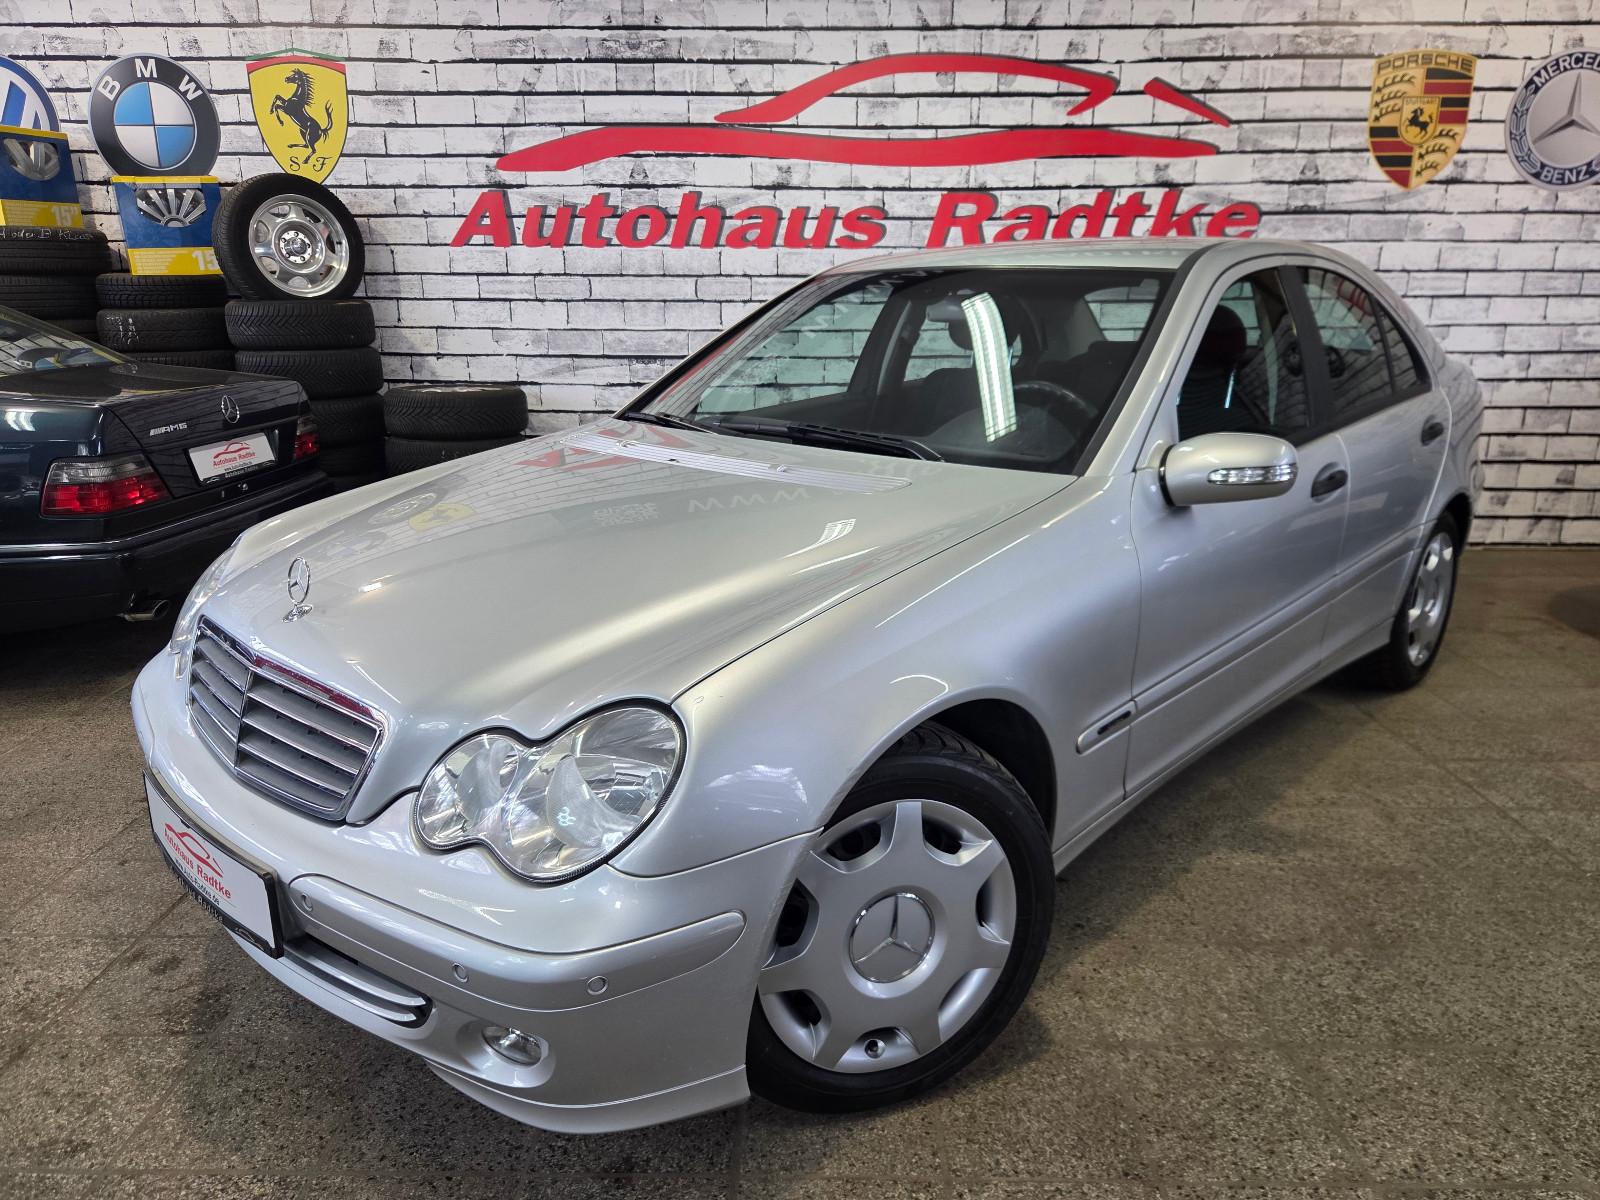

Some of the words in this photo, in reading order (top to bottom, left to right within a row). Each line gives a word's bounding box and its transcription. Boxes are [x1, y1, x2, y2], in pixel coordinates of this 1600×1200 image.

[97, 58, 203, 101] BMW
[1377, 53, 1474, 74] PORSCHE
[1540, 165, 1589, 185] BENZ
[450, 190, 888, 249] Autohaus
[925, 188, 1262, 249] Radtke
[196, 863, 232, 899] Radtke
